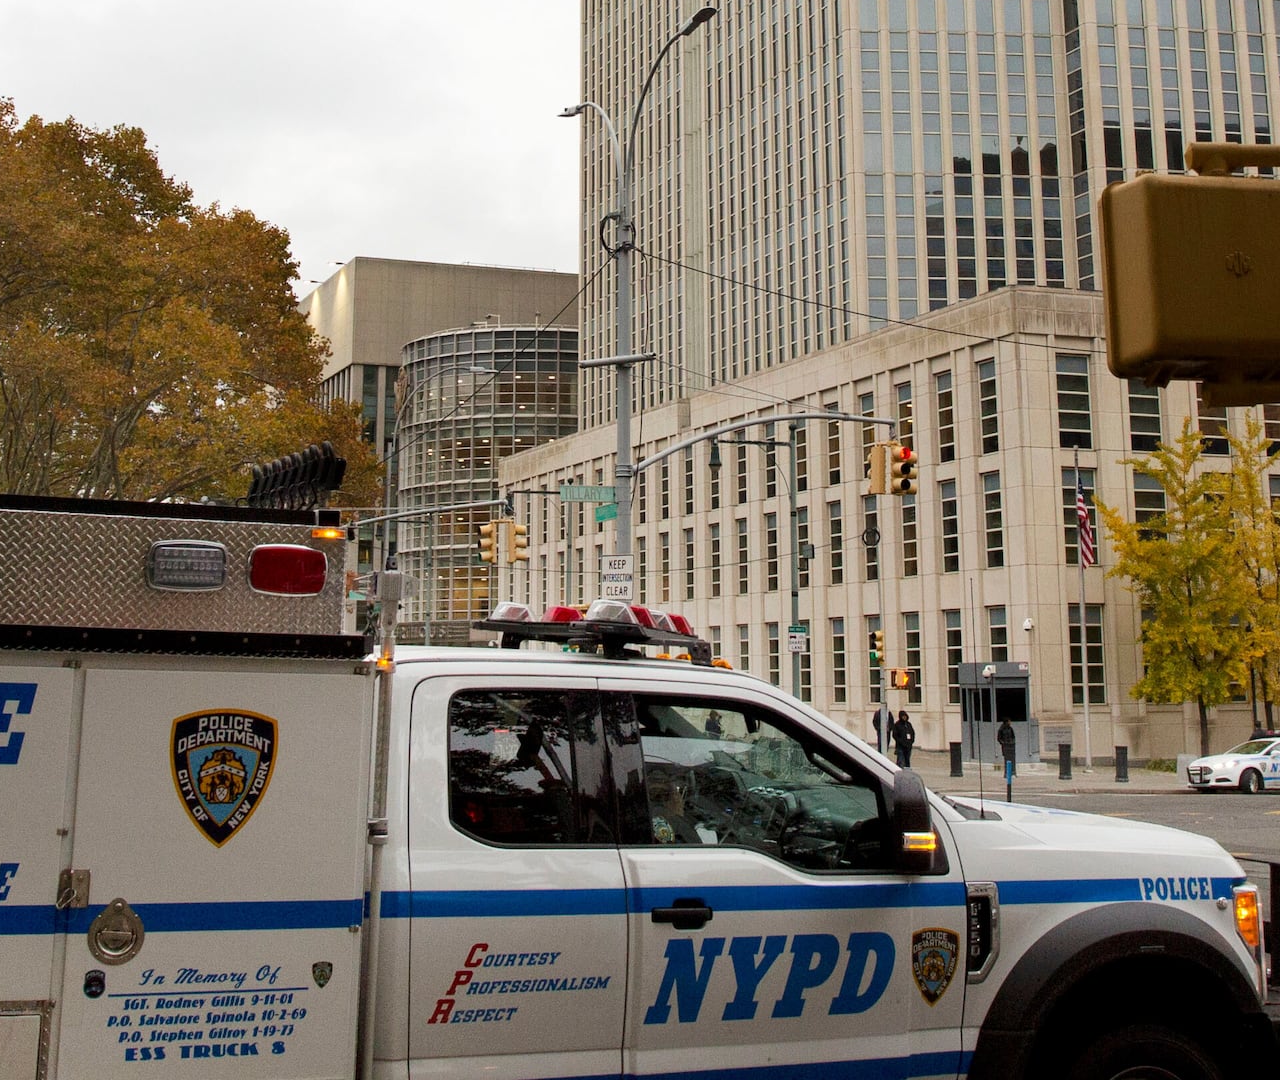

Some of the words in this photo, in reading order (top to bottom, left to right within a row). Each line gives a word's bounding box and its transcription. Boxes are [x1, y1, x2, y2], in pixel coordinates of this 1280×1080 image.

[565, 487, 601, 500] TILLARY
[609, 560, 627, 569] KEEP
[602, 574, 633, 582] INTERSECTION
[606, 586, 628, 596] CLEAR
[199, 716, 254, 732] POLICE
[178, 729, 271, 754] DEPARTMENT
[178, 769, 196, 800] CITY
[192, 806, 209, 822] OF
[227, 800, 252, 829] NEW
[249, 761, 270, 796] YORK
[1141, 877, 1212, 902] POLICE
[922, 931, 949, 940] POLICE
[464, 943, 561, 968] COURTESY
[913, 939, 957, 954] DEPARTMENT
[139, 969, 165, 986] In
[174, 968, 248, 989] Memory
[255, 965, 282, 985] Of
[445, 970, 611, 996] PROFESSIONALISM
[642, 931, 896, 1025] NYPD
[123, 998, 149, 1010] SGT.
[155, 997, 207, 1009] Rodney
[211, 995, 245, 1007] Gillis
[251, 993, 294, 1005] 9-11-01
[427, 998, 518, 1024] RESPECT
[107, 1015, 132, 1027] P.O.
[138, 1014, 200, 1026] Salvatore
[205, 1011, 256, 1025] Spinola
[261, 1008, 307, 1021] 10-2-69
[118, 1030, 144, 1043] P.O.
[149, 1029, 204, 1042] Stephen
[208, 1027, 247, 1039] Gilroy
[252, 1024, 294, 1037] 1-19-73
[125, 1046, 166, 1061] ESS
[179, 1042, 259, 1059] TRUCK
[271, 1040, 286, 1055] 8
